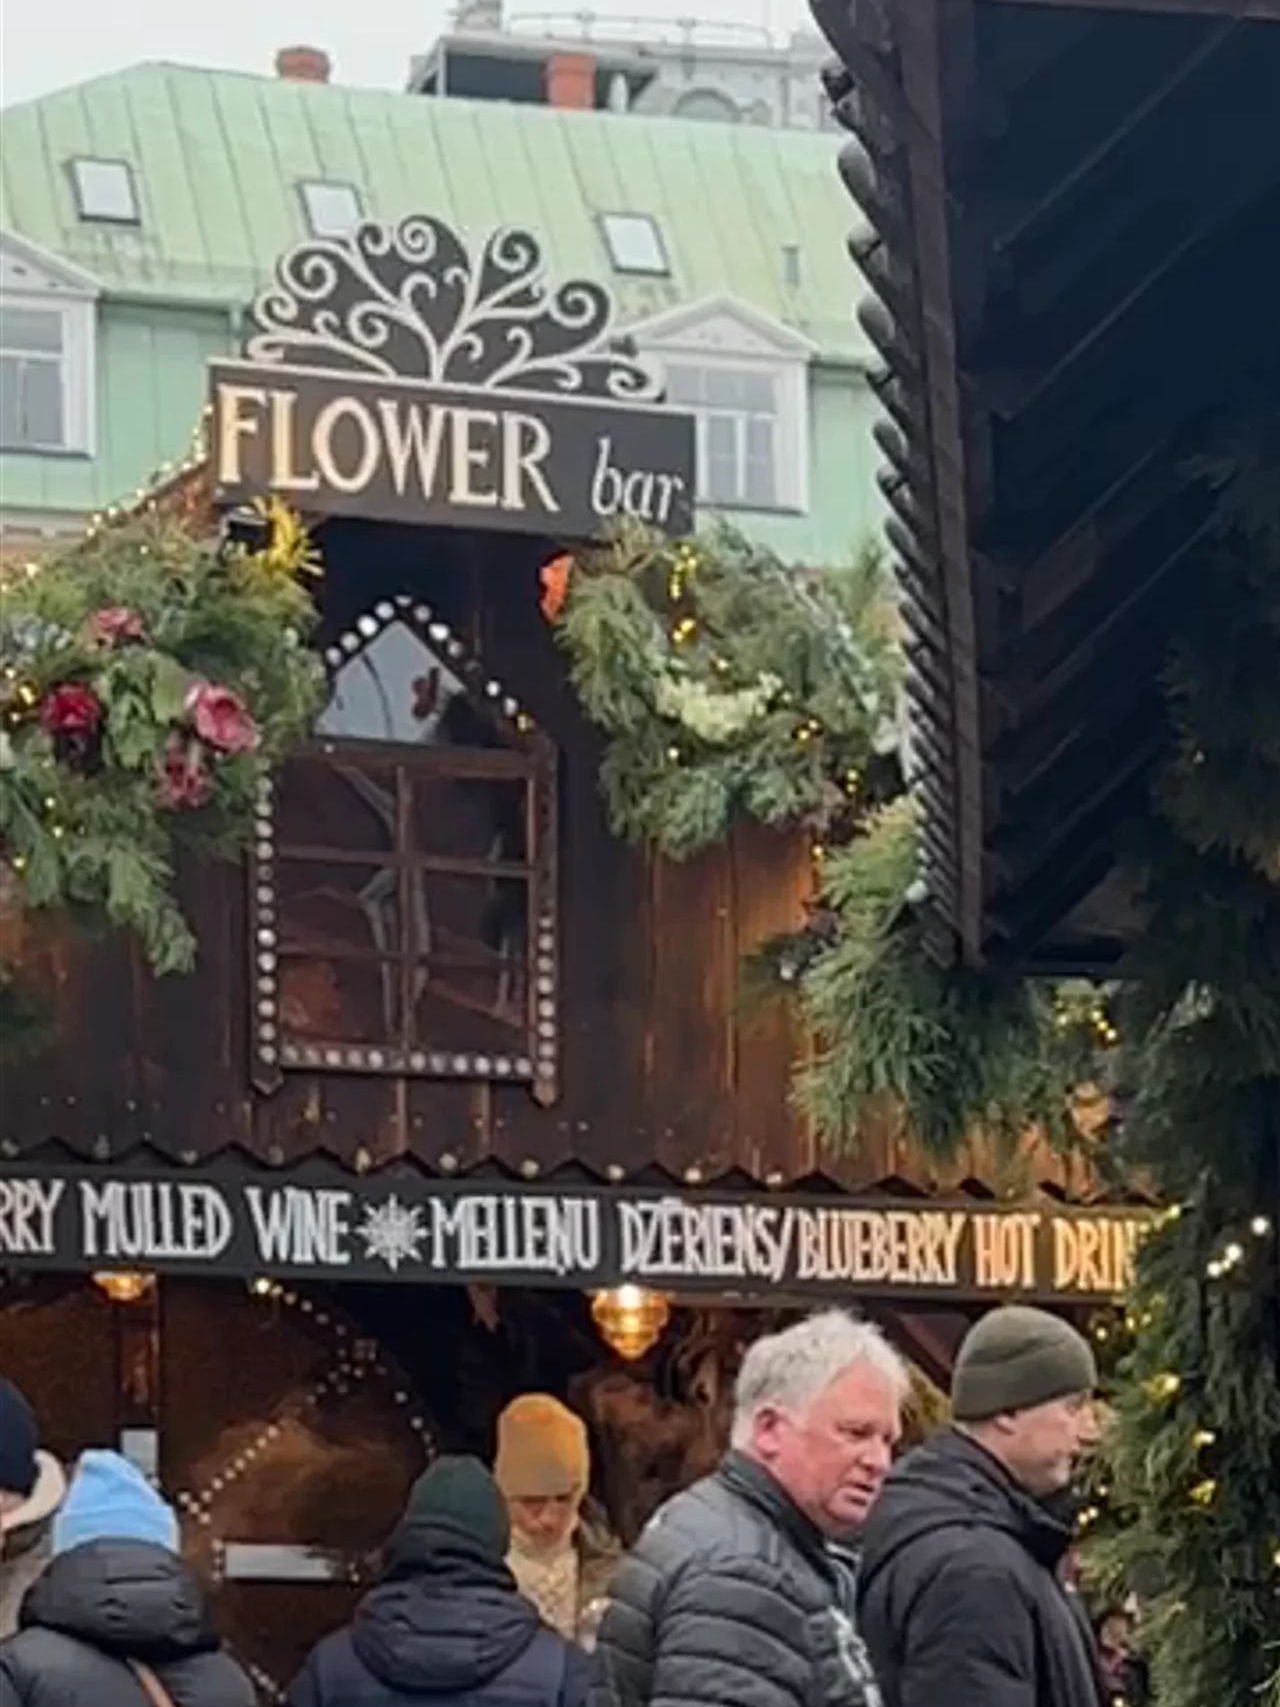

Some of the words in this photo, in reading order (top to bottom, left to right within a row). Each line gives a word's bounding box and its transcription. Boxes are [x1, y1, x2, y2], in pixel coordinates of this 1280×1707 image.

[216, 382, 561, 513] FLOWER
[591, 436, 684, 523] bar
[79, 1180, 232, 1259] MULLED
[244, 1185, 352, 1264] WINE
[973, 1211, 1042, 1289] HOT
[1051, 1217, 1150, 1292] DRIN
